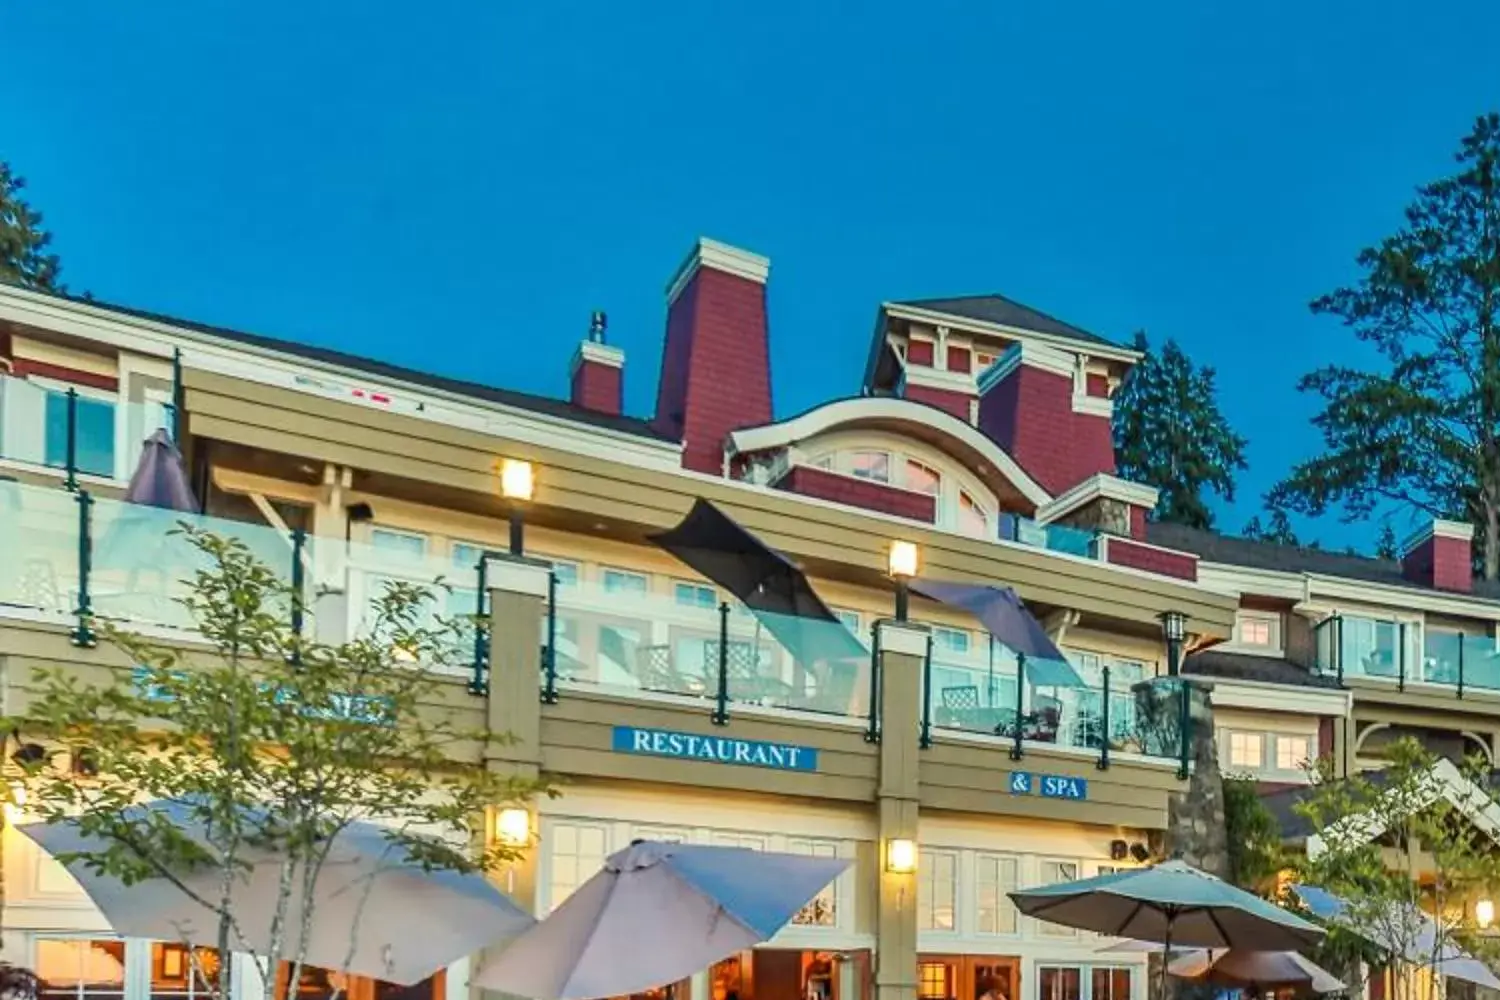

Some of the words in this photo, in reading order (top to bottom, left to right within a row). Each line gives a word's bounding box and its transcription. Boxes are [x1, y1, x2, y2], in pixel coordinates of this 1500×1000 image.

[633, 729, 801, 768] RESTAURANT
[1012, 773, 1029, 792] &
[1045, 777, 1080, 797] SPA
